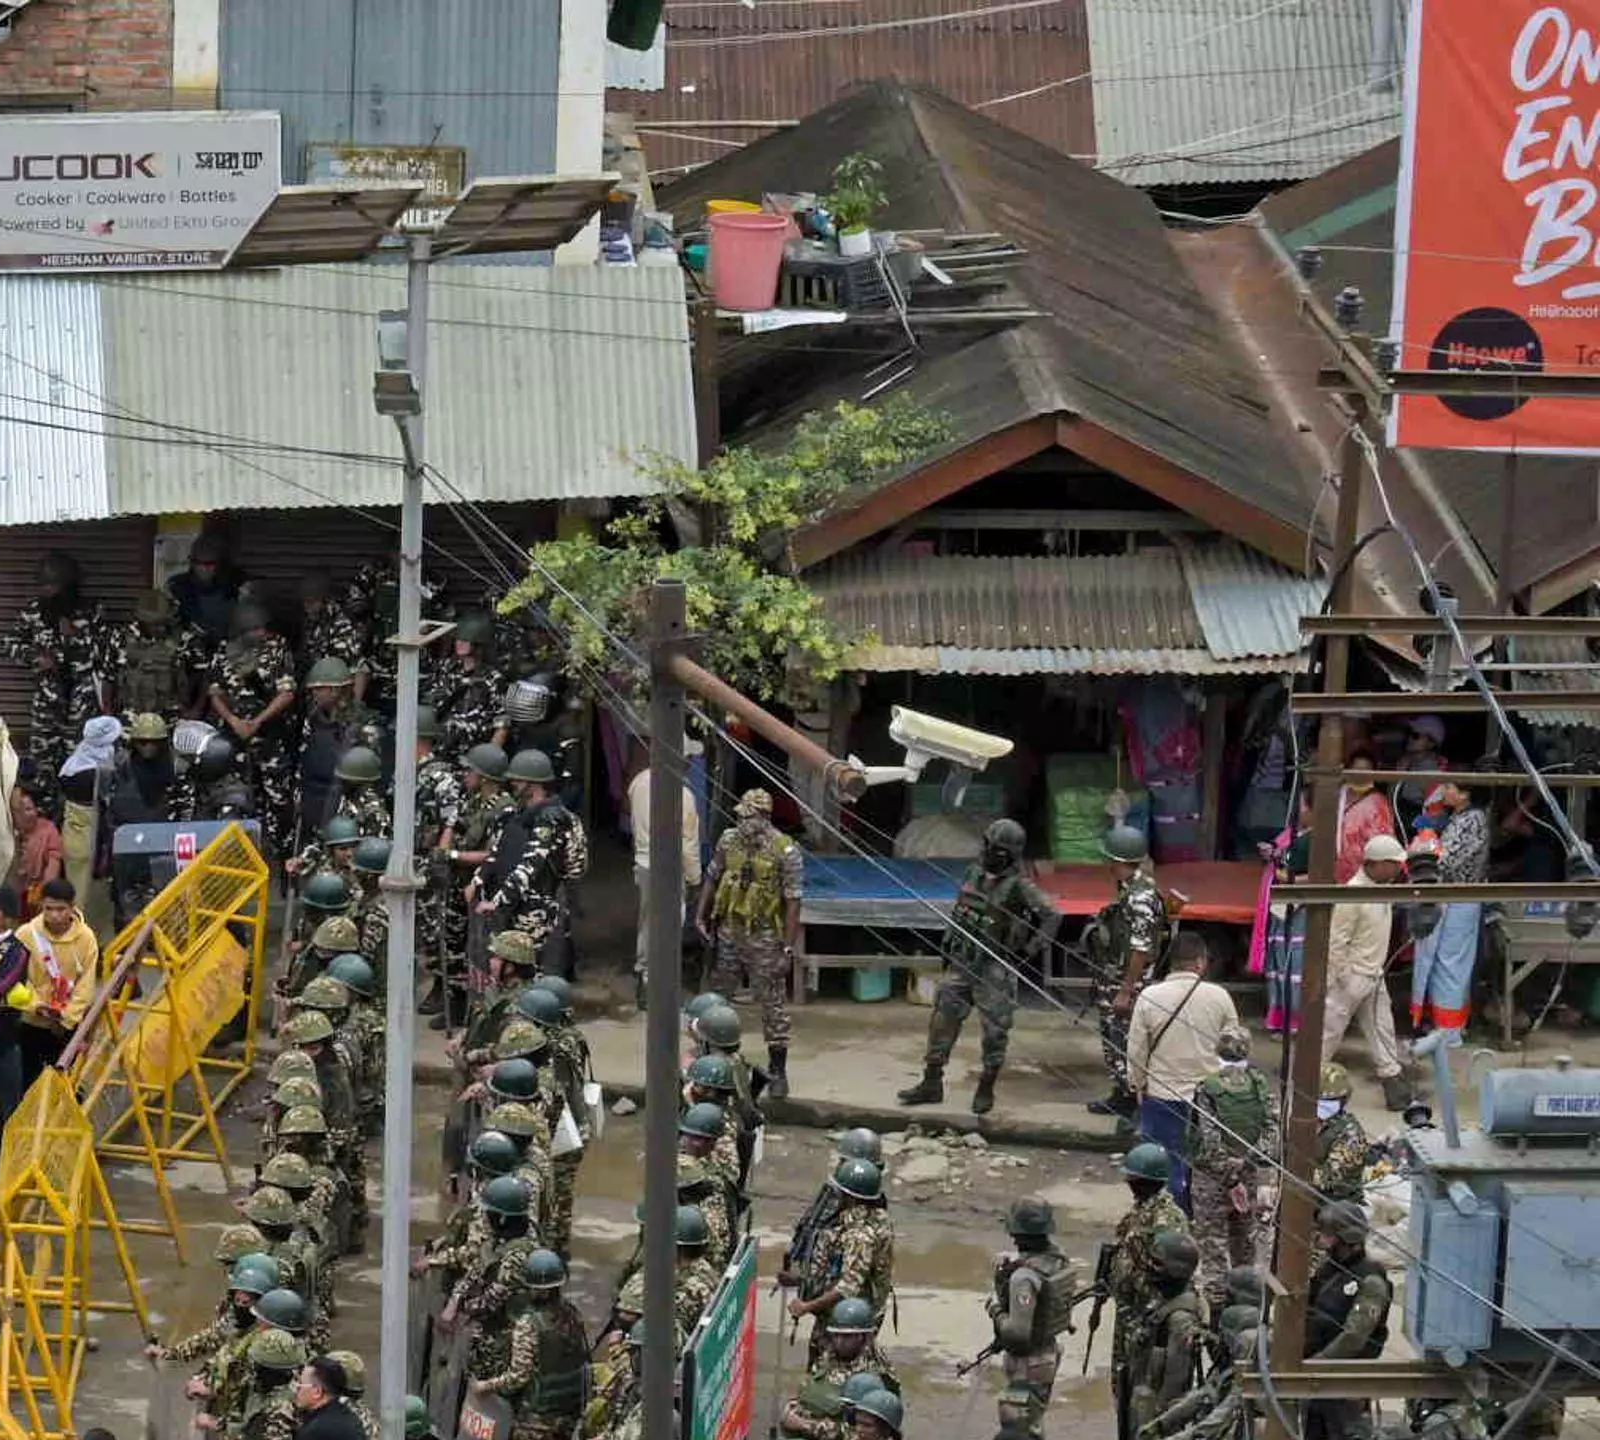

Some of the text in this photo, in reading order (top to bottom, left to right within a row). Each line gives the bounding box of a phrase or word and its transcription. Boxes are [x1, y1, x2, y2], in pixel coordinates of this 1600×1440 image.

[15, 190, 237, 206] Cooker Cookware Bottles
[66, 216, 85, 231] by
[211, 215, 252, 230] Grou
[167, 251, 212, 265] STORE
